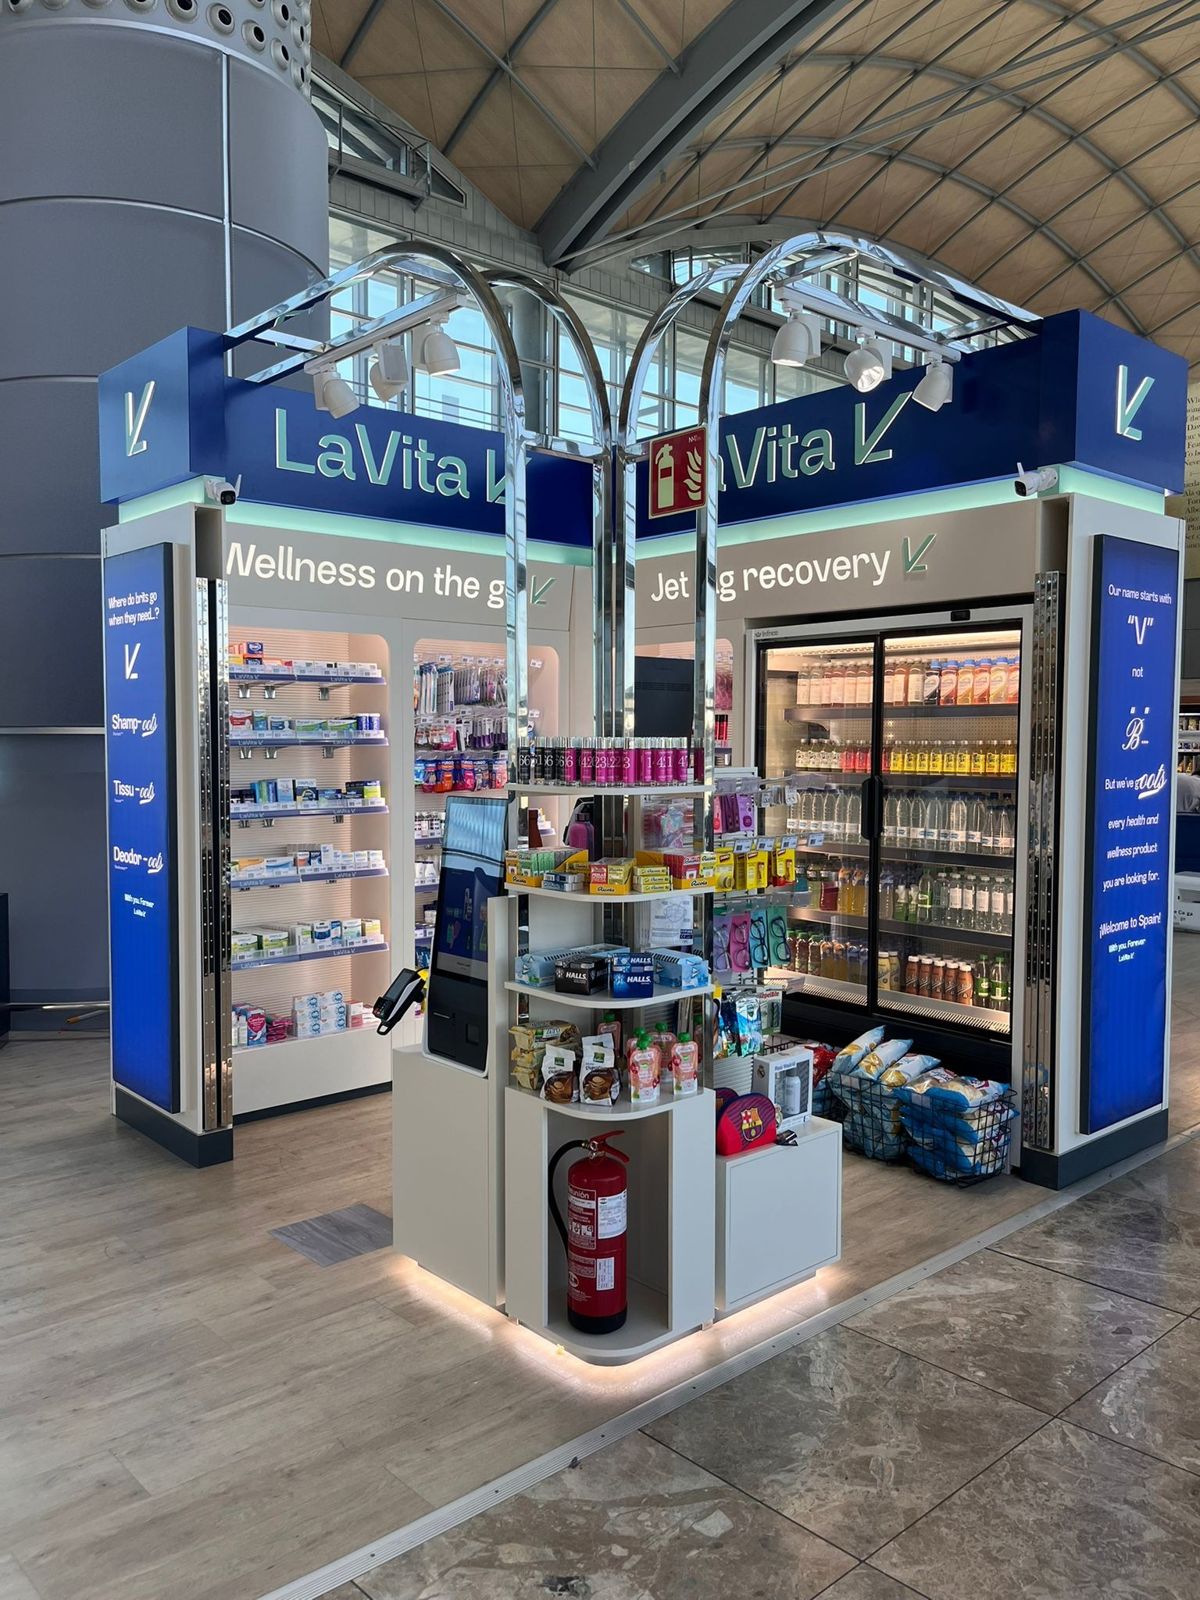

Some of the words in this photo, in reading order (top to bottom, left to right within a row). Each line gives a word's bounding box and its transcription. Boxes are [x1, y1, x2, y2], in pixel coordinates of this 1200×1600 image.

[275, 407, 471, 500] LaVita
[717, 423, 836, 492] Vita
[650, 571, 690, 602] Jet
[742, 550, 891, 592] recovery
[385, 567, 425, 594] on
[433, 564, 480, 599] the
[486, 579, 505, 609] g
[1108, 584, 1121, 597] Our
[1122, 589, 1139, 600] name
[1140, 590, 1158, 603] starts
[1159, 593, 1172, 605] with
[108, 596, 127, 609] Where
[128, 593, 134, 605] do
[150, 592, 158, 605] go
[108, 613, 124, 626] when
[124, 611, 137, 626] they
[1131, 666, 1144, 678] not
[1105, 778, 1115, 790] But
[1108, 819, 1126, 830] every
[1126, 814, 1145, 827] health
[1146, 813, 1160, 825] and
[1107, 846, 1131, 859] wellness
[1132, 842, 1158, 858] product
[1103, 879, 1114, 892] you
[1114, 877, 1125, 887] are
[1126, 872, 1147, 886] looking
[1130, 917, 1138, 928] to
[1138, 912, 1161, 929] Spain!
[566, 971, 587, 980] HALLS
[627, 975, 651, 984] HALLS
